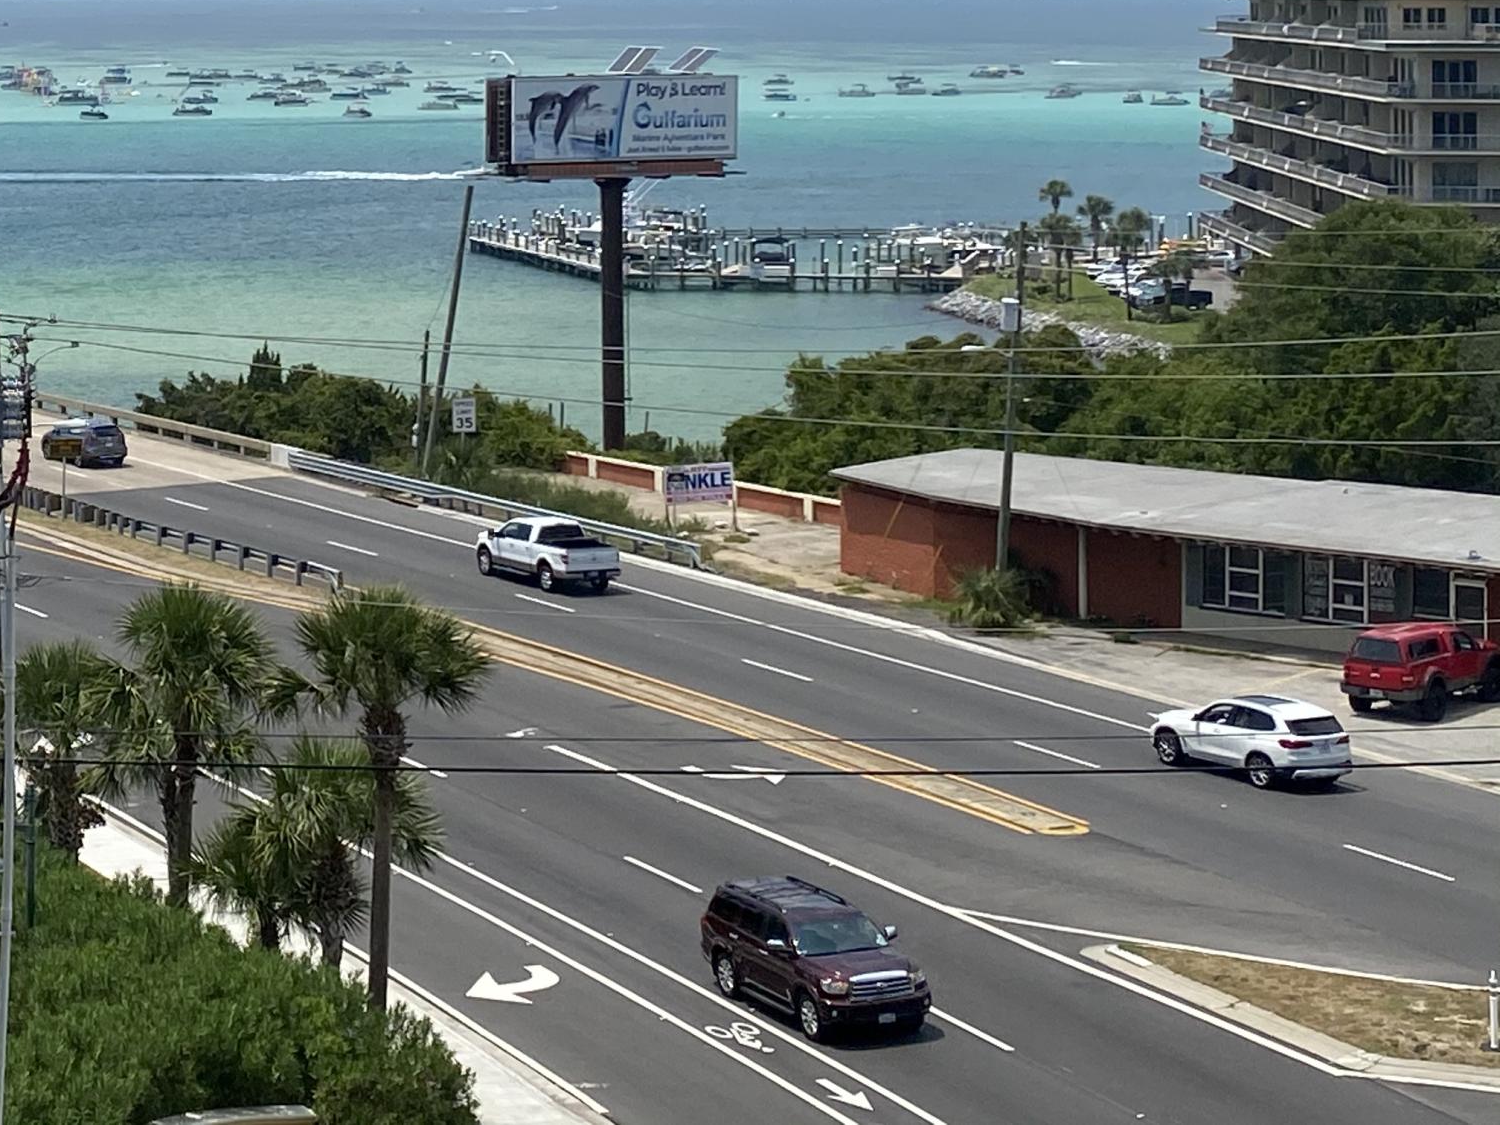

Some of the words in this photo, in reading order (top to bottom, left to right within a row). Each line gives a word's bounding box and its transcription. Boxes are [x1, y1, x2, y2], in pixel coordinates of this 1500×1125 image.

[636, 81, 667, 99] Play
[681, 81, 726, 96] Learn!
[632, 101, 726, 129] Gulfarium
[456, 417, 473, 429] 35
[1369, 563, 1396, 588] BOOK
